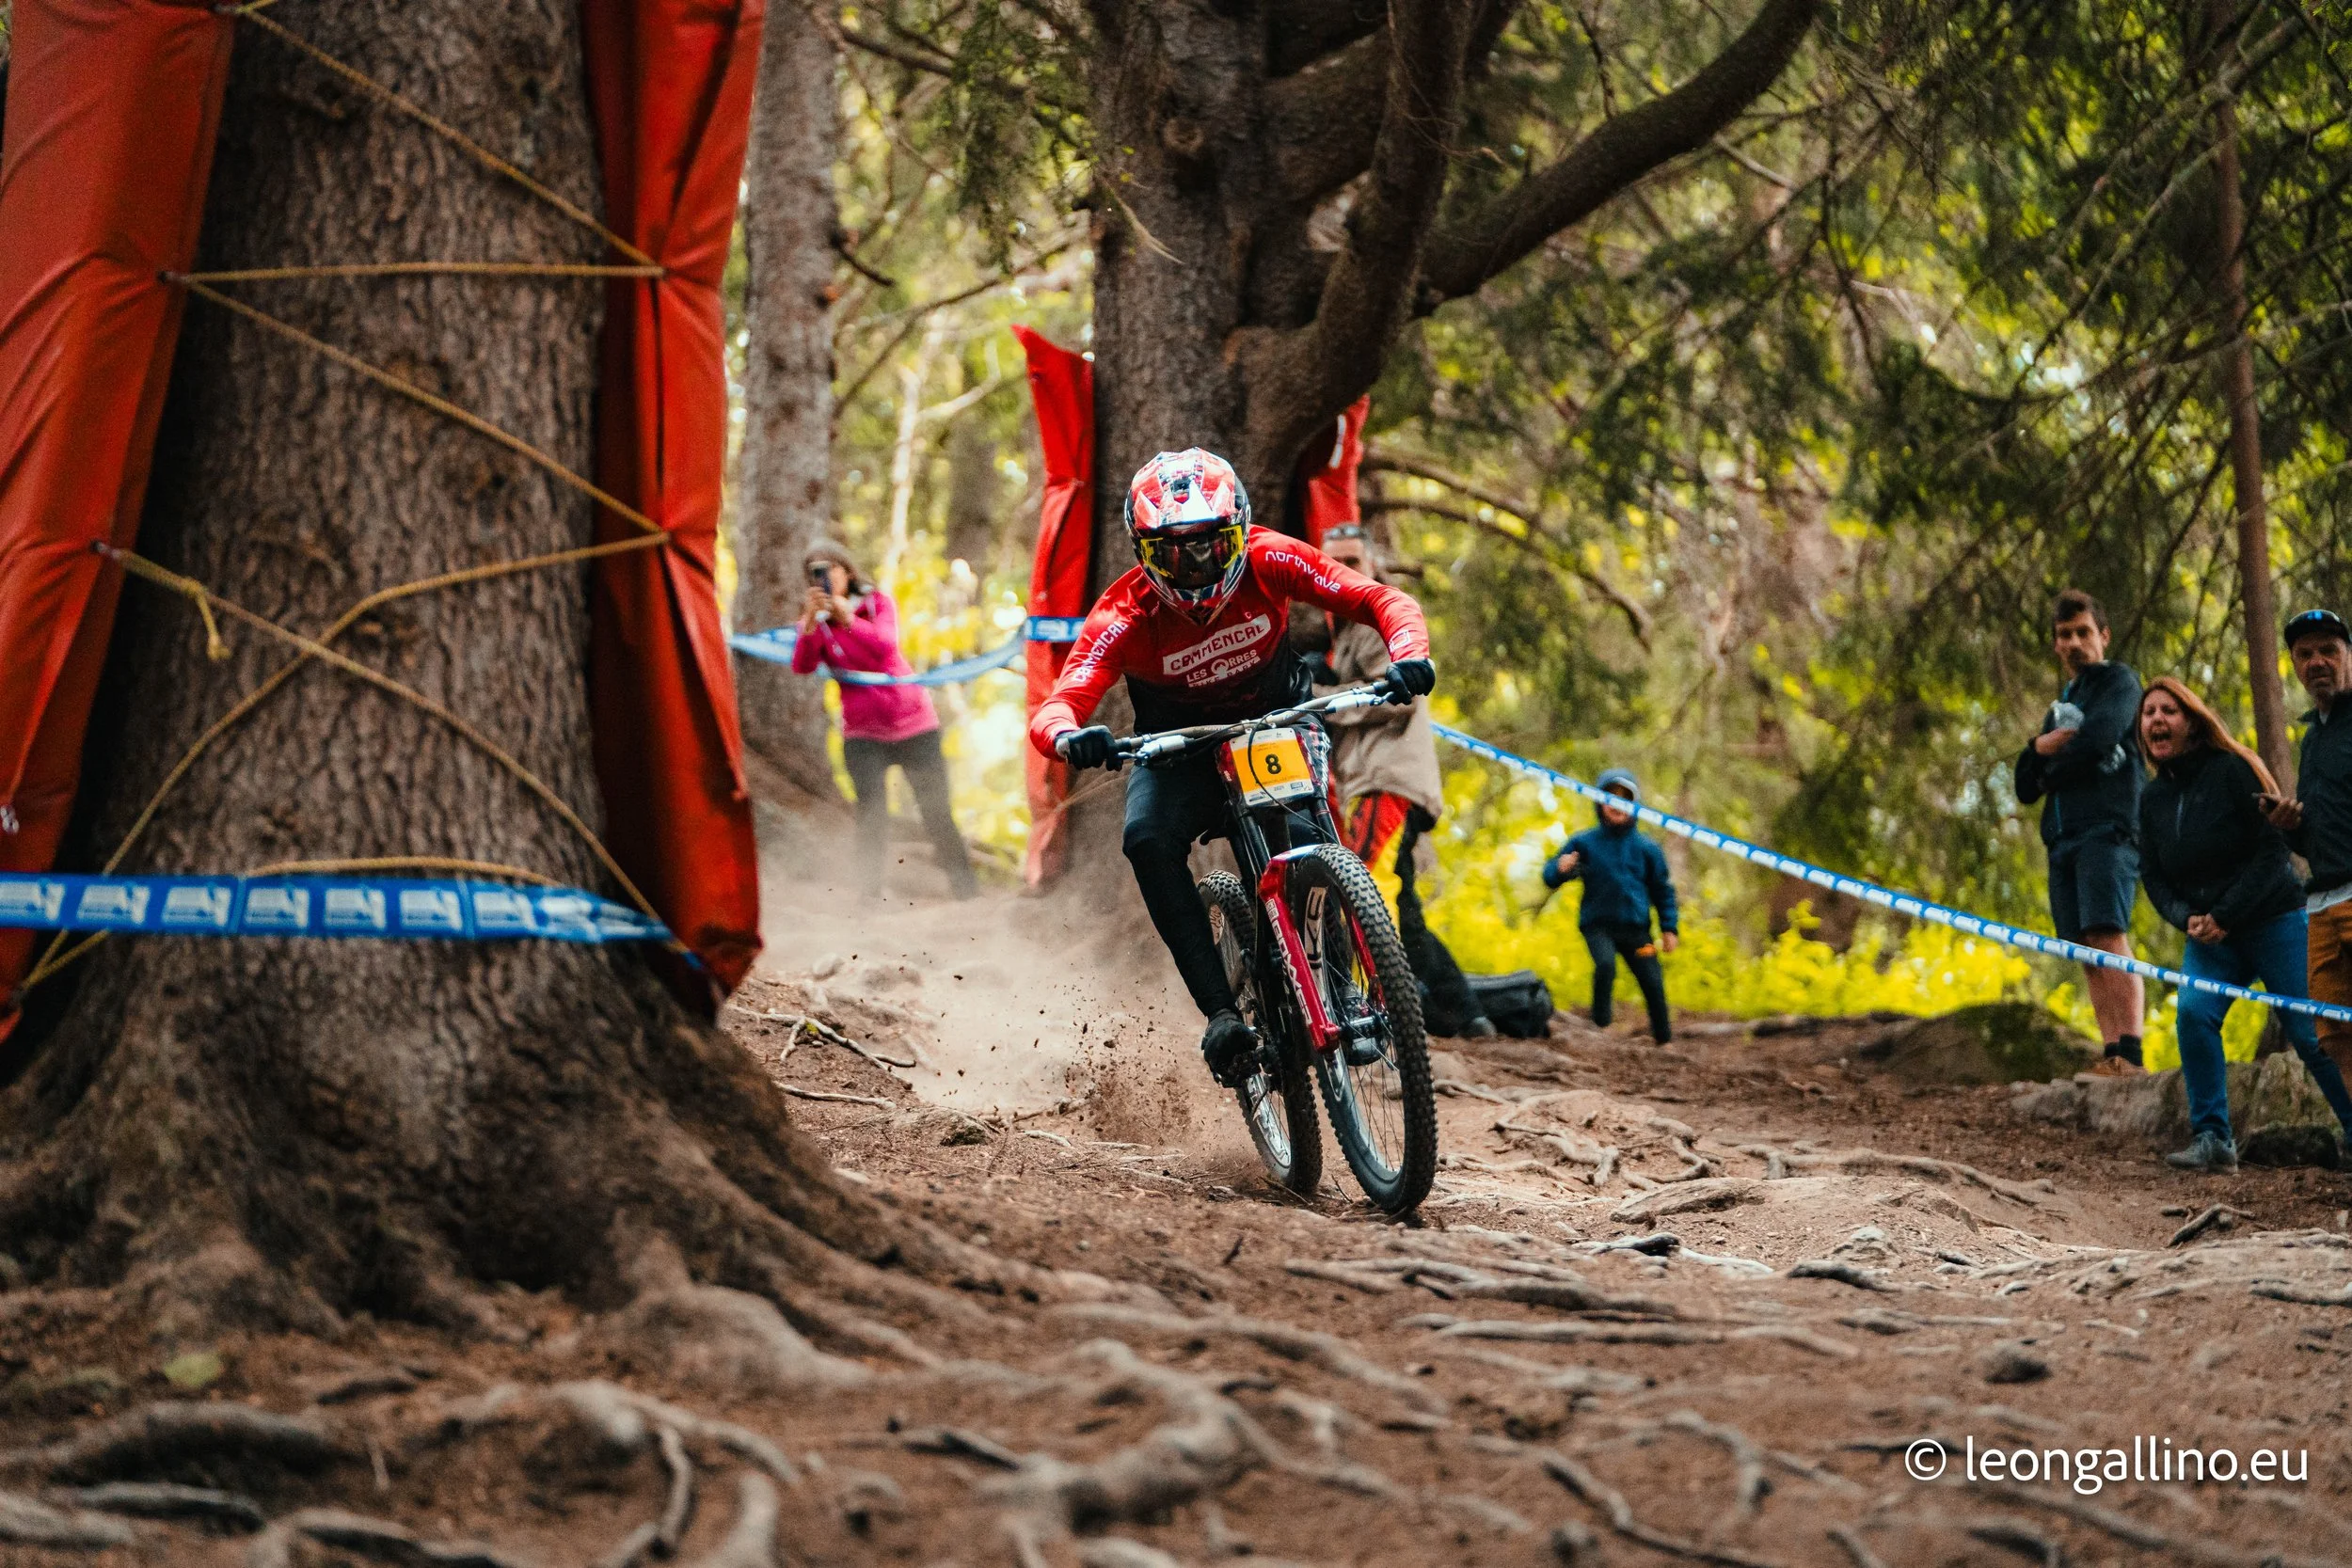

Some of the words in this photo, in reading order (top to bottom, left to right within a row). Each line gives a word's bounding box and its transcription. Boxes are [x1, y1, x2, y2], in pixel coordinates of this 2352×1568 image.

[1265, 551, 1342, 594] northwave
[1170, 625, 1264, 671] COMMENCAL
[1186, 669, 1207, 683] LES
[1265, 753, 1281, 774] 8
[1272, 919, 1313, 1025] BOXXER
